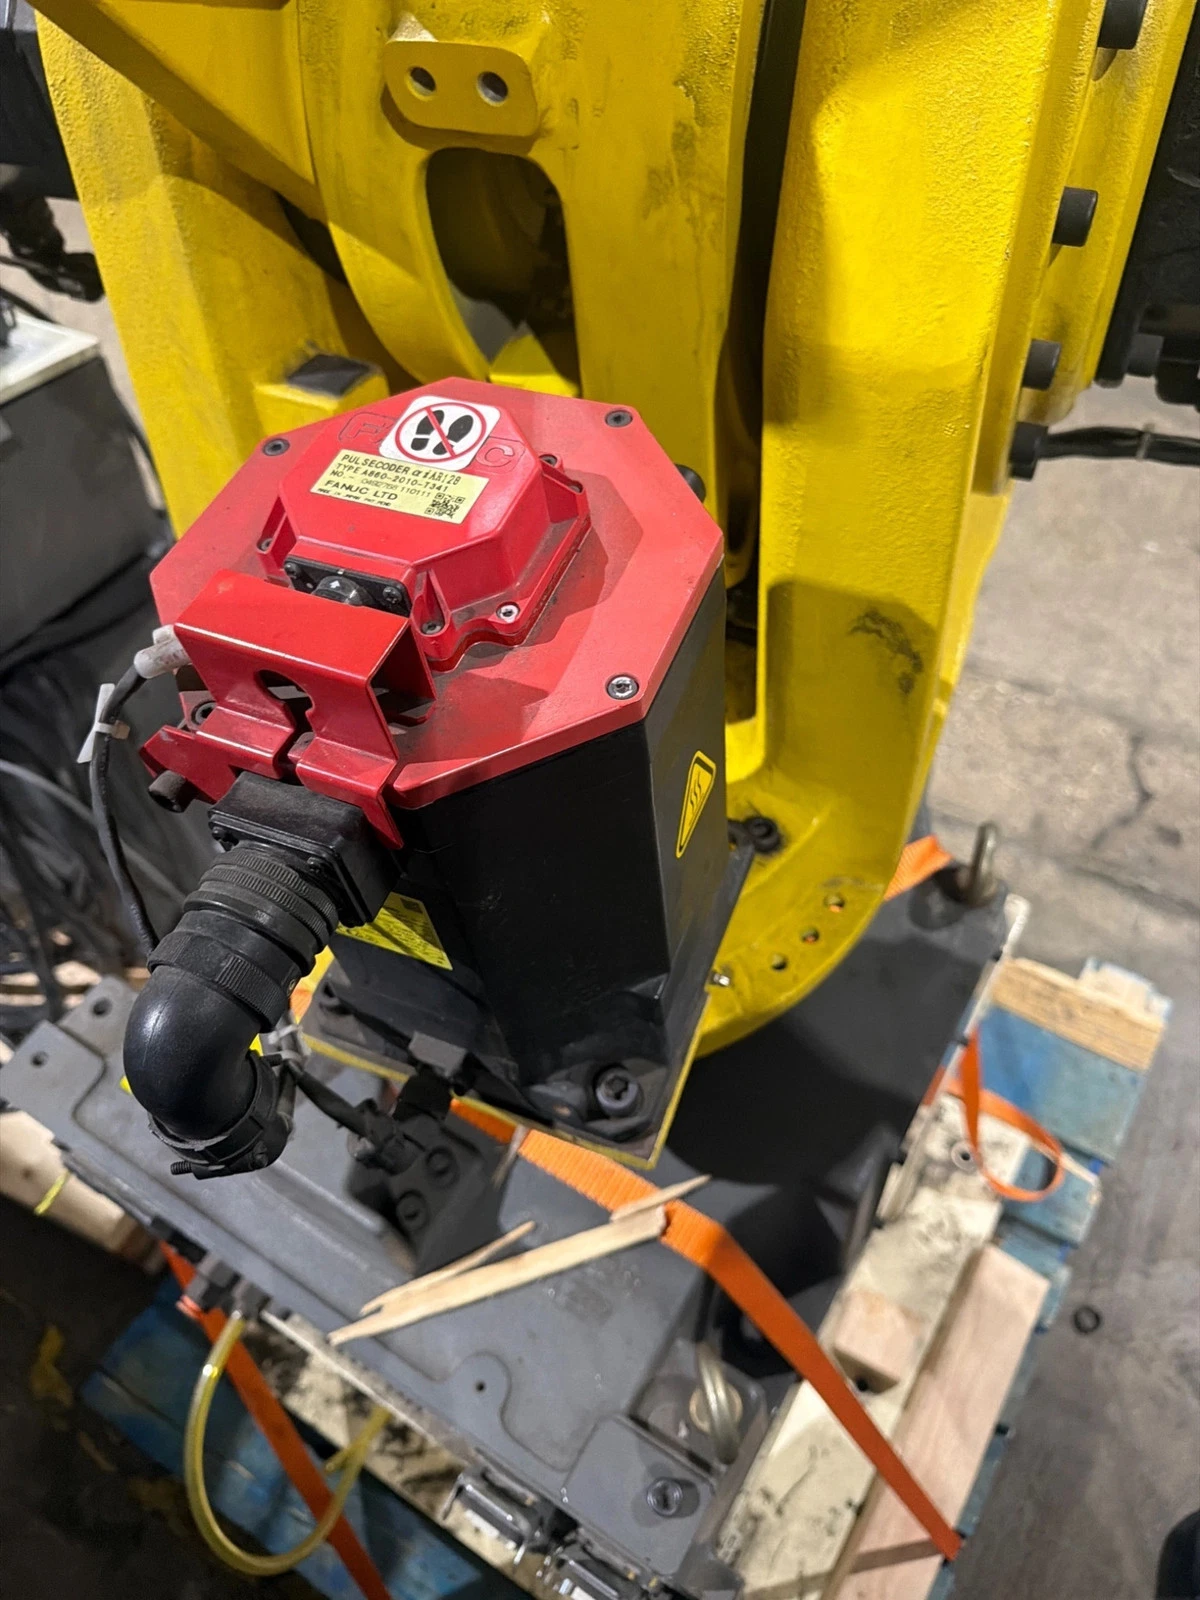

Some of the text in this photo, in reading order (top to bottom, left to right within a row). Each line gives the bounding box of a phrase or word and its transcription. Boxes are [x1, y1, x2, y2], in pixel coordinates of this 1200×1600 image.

[336, 463, 362, 474] TYPE
[341, 454, 411, 475] PULSECODER
[325, 480, 398, 501] FANUC LTD
